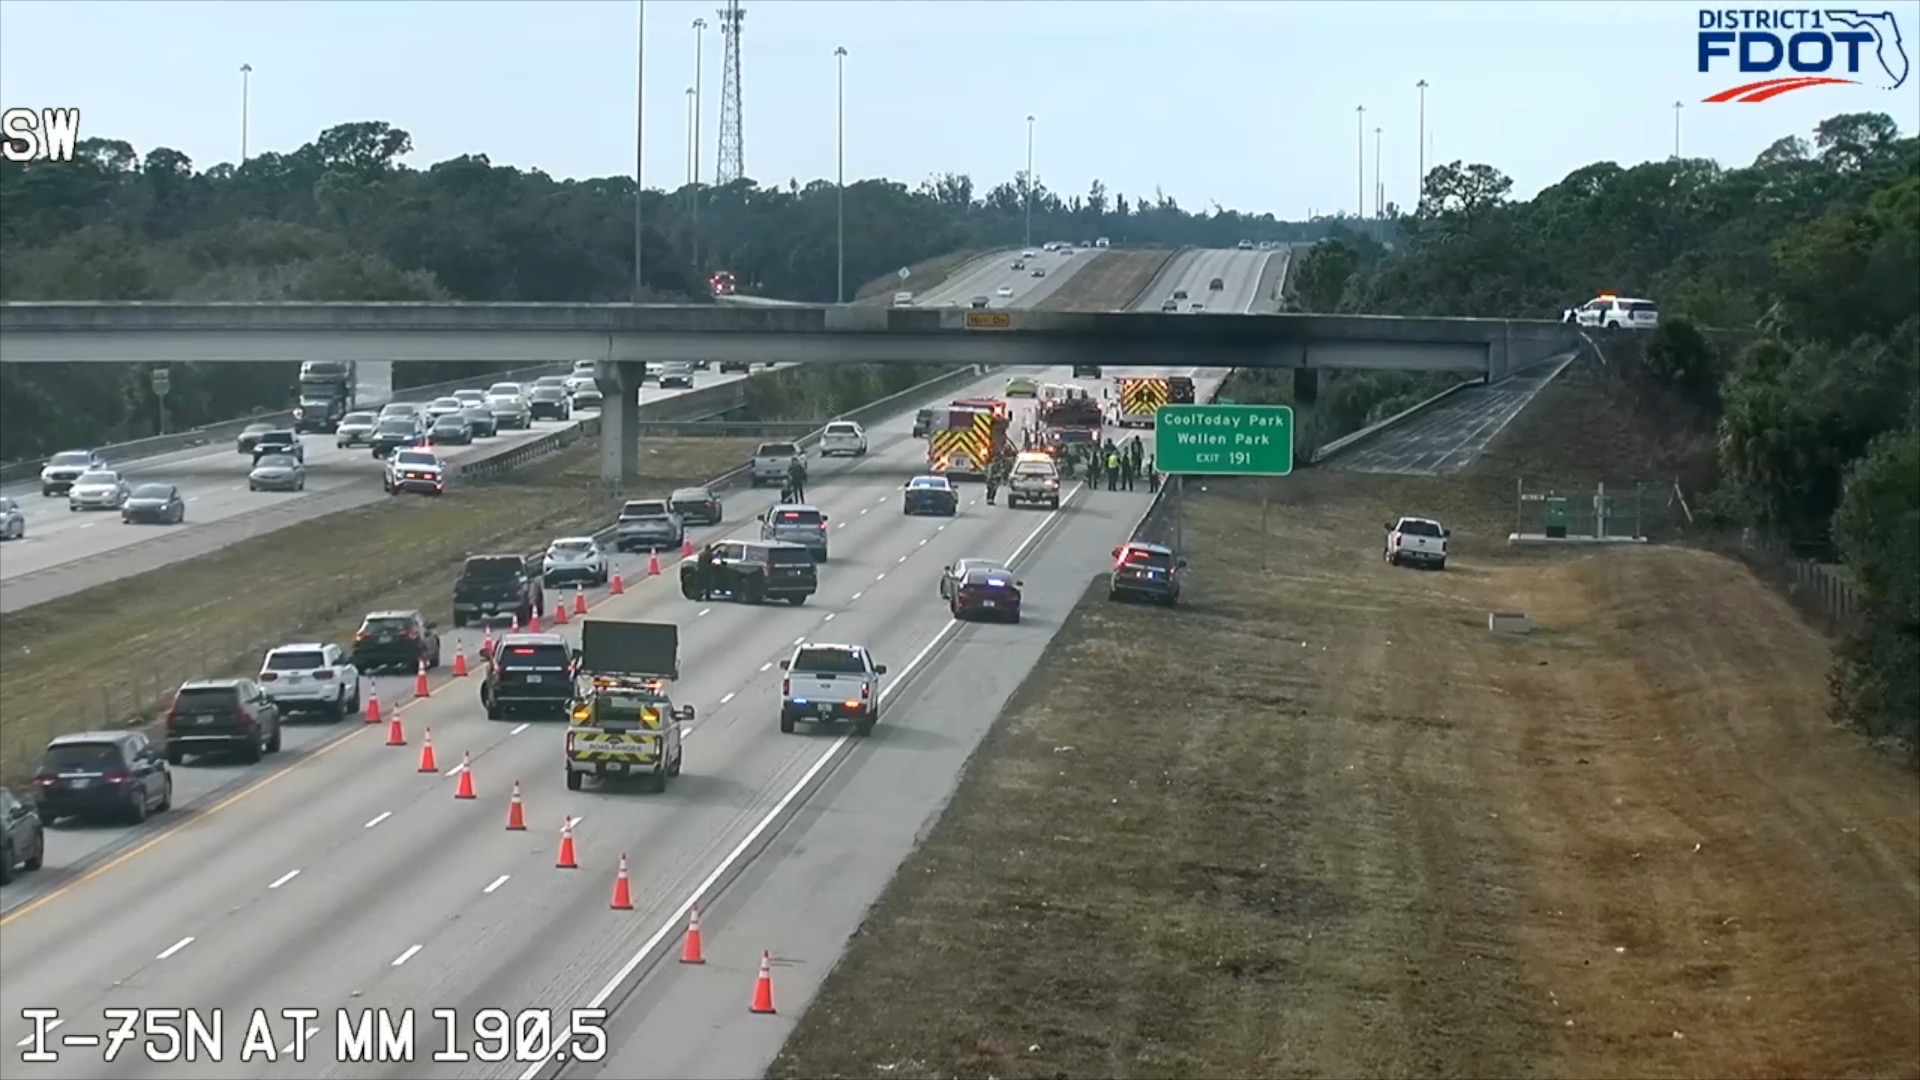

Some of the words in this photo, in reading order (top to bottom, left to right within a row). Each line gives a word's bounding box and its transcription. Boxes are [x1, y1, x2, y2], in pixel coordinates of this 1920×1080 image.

[1163, 413, 1242, 428] CoolToday
[1249, 414, 1284, 427] Park
[1177, 433, 1227, 446] Wellen
[1235, 433, 1270, 446] Park
[1196, 453, 1220, 463] EXIT
[1229, 452, 1251, 465] 191
